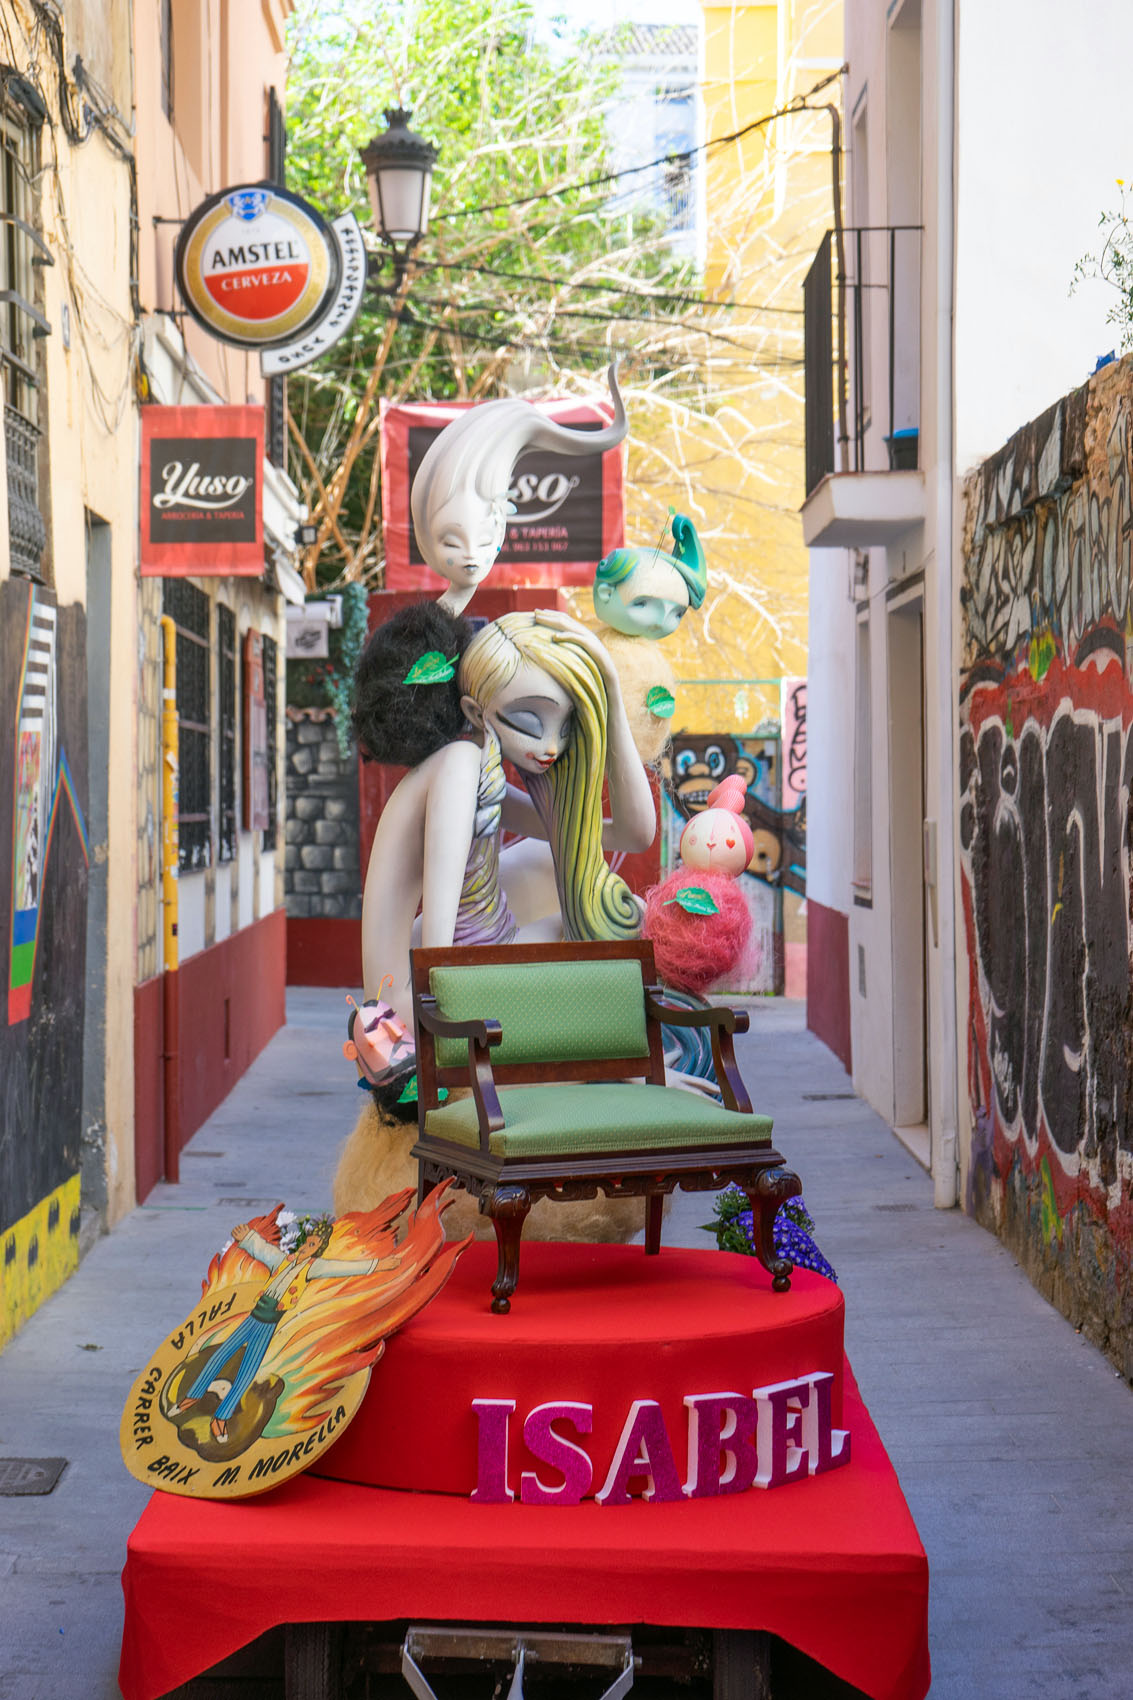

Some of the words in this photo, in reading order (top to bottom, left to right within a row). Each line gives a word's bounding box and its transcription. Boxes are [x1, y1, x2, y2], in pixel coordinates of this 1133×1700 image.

[212, 240, 299, 269] AMSTEL
[221, 271, 292, 291] CERVEZA
[153, 461, 253, 509] Yuso
[509, 527, 519, 539] &
[522, 526, 568, 539] TAPERÍA
[171, 1292, 237, 1351] FALLA
[133, 1367, 163, 1450] CARRER
[248, 1405, 346, 1481] MORELLA
[469, 1371, 851, 1505] ISABEL
[147, 1455, 200, 1486] BAIX
[213, 1465, 241, 1487] M.
